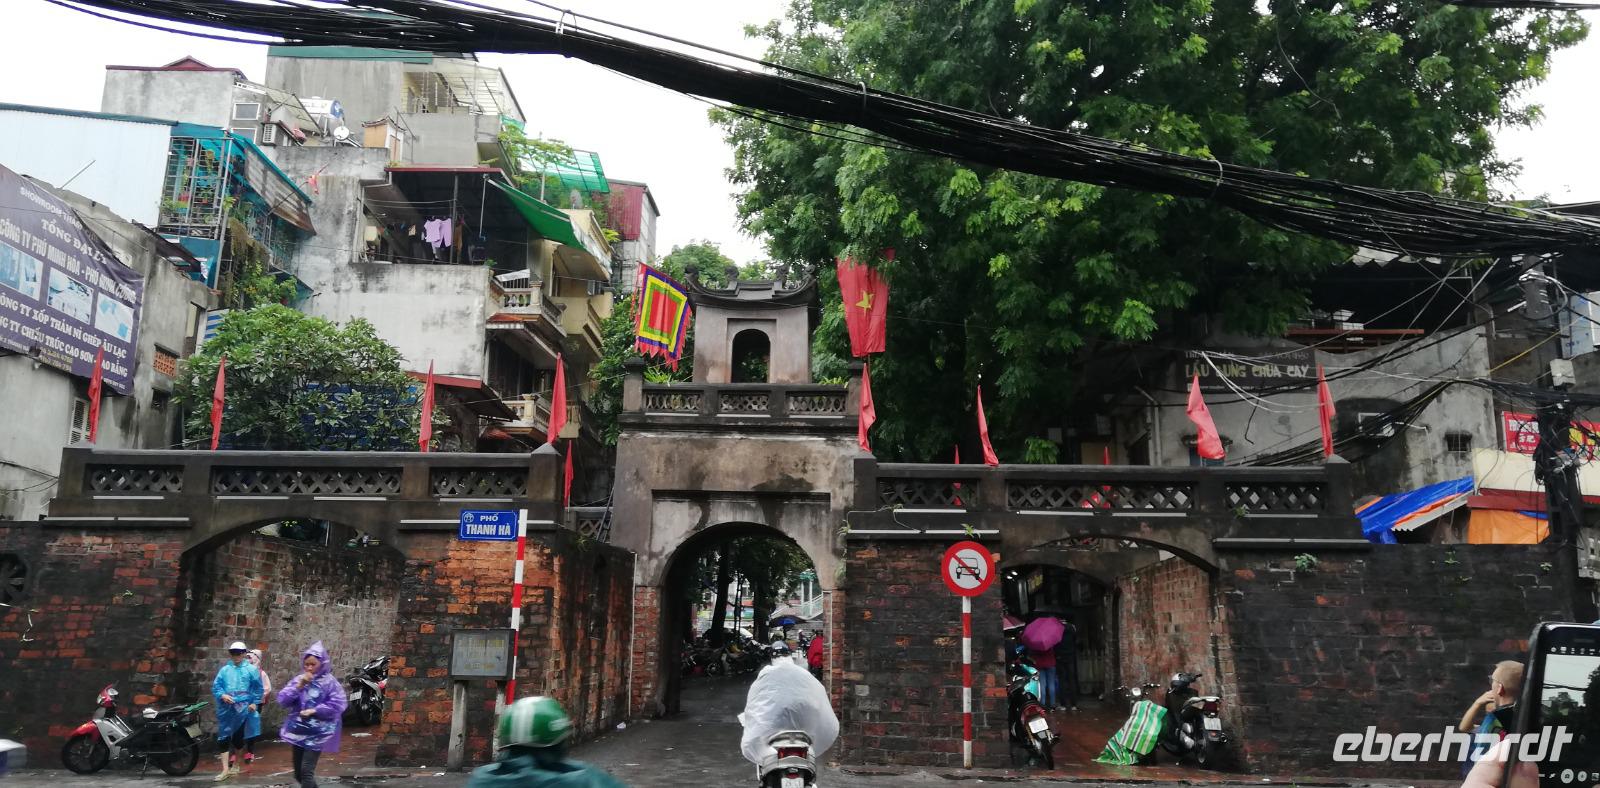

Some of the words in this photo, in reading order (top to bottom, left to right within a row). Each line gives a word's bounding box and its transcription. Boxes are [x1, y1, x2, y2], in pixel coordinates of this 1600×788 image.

[41, 218, 72, 243] TỔNG
[0, 218, 21, 244] CÔNG
[22, 231, 31, 249] TY
[31, 237, 47, 257] PHÚ
[47, 244, 67, 268] MINH
[85, 266, 99, 285] PHÚ
[99, 273, 116, 295] MINH
[0, 292, 19, 311] ÔNG
[19, 303, 33, 317] TY
[32, 308, 50, 325] XỐP
[50, 317, 72, 336] THẢM
[82, 332, 102, 348] GHÉP
[113, 345, 128, 359] LẠC
[9, 319, 21, 333] TY
[21, 325, 45, 343] CHIẾU
[45, 334, 65, 353] TRÚC
[64, 345, 80, 359] CAO
[101, 360, 111, 372] AO
[1287, 364, 1309, 378] CAY
[466, 524, 497, 536] THANH
[498, 522, 511, 536] HÀ
[479, 512, 499, 522] PHỐ
